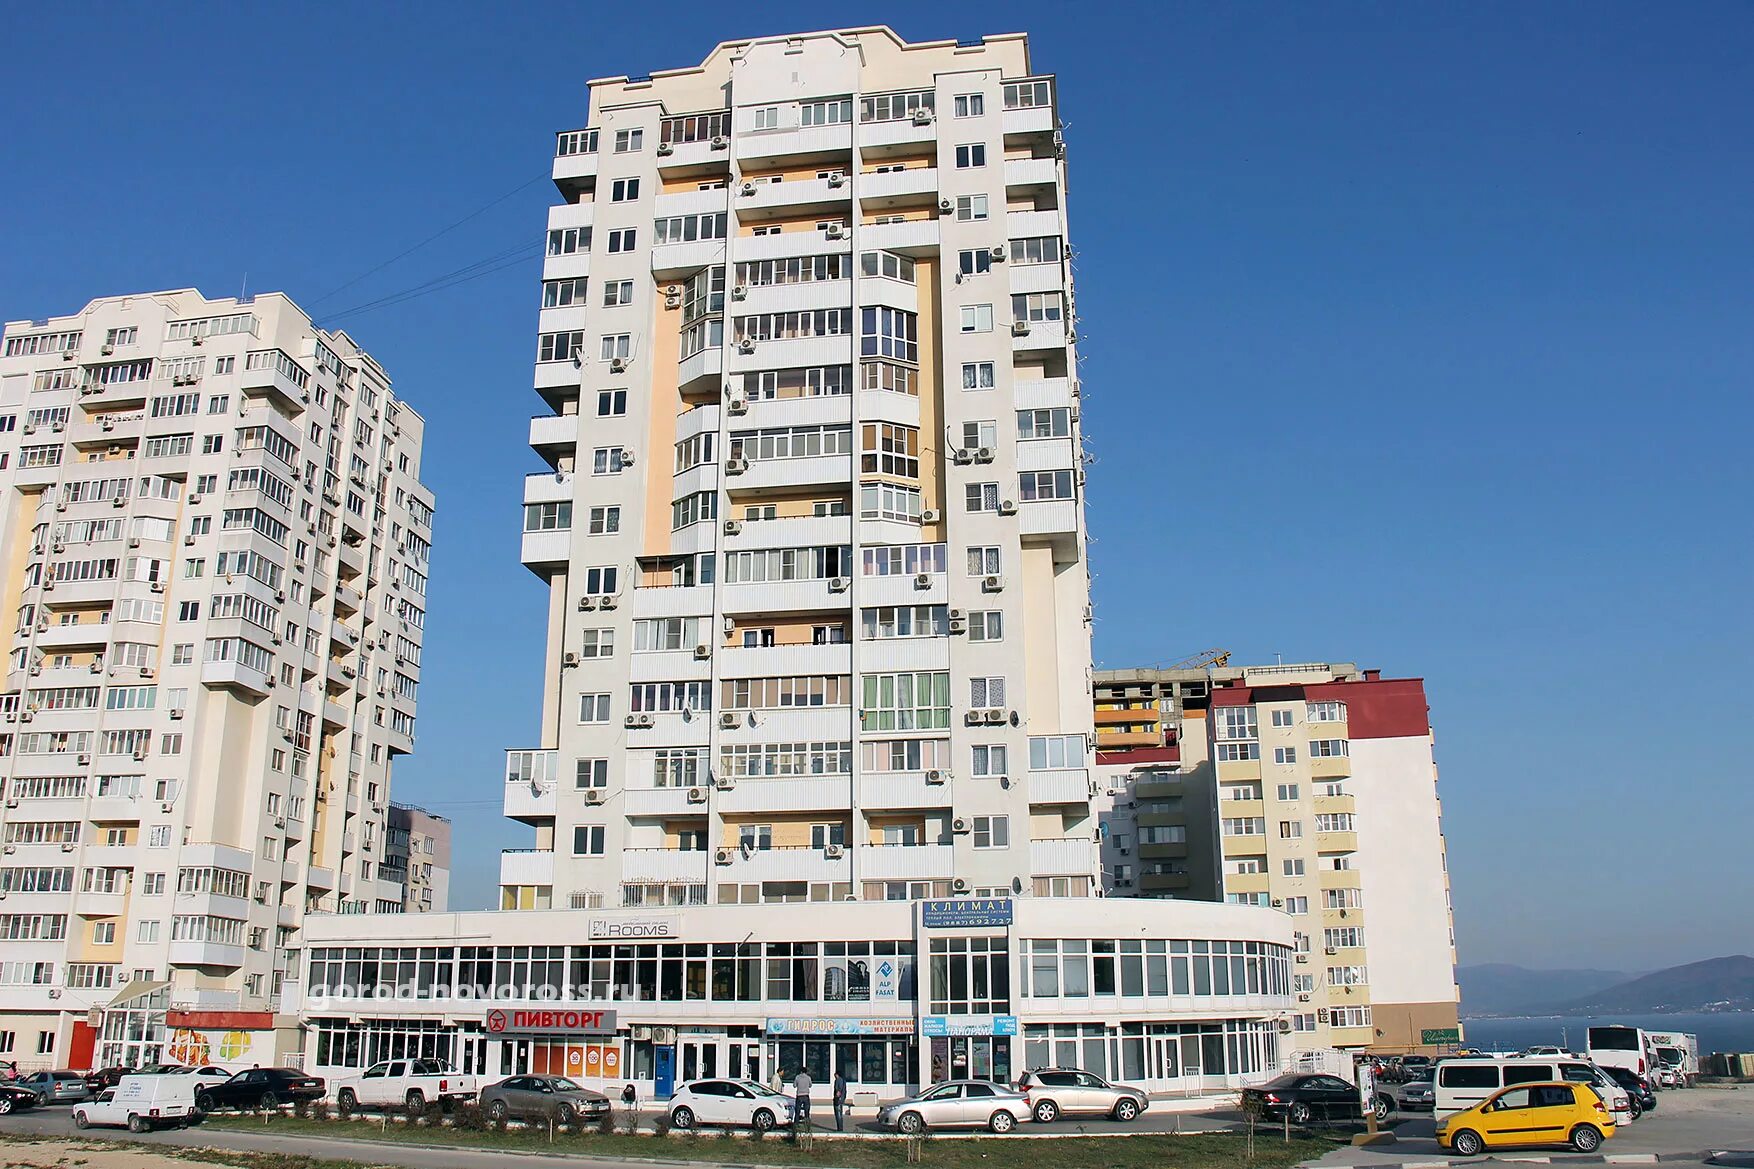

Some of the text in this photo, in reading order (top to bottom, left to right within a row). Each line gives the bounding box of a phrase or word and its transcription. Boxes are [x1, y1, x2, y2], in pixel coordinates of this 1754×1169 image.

[930, 900, 1006, 912] КЛИМАТ
[608, 924, 669, 937] ROOMS
[513, 1011, 605, 1028] ПИВТОРГ
[787, 1020, 835, 1032] ГИДРОС
